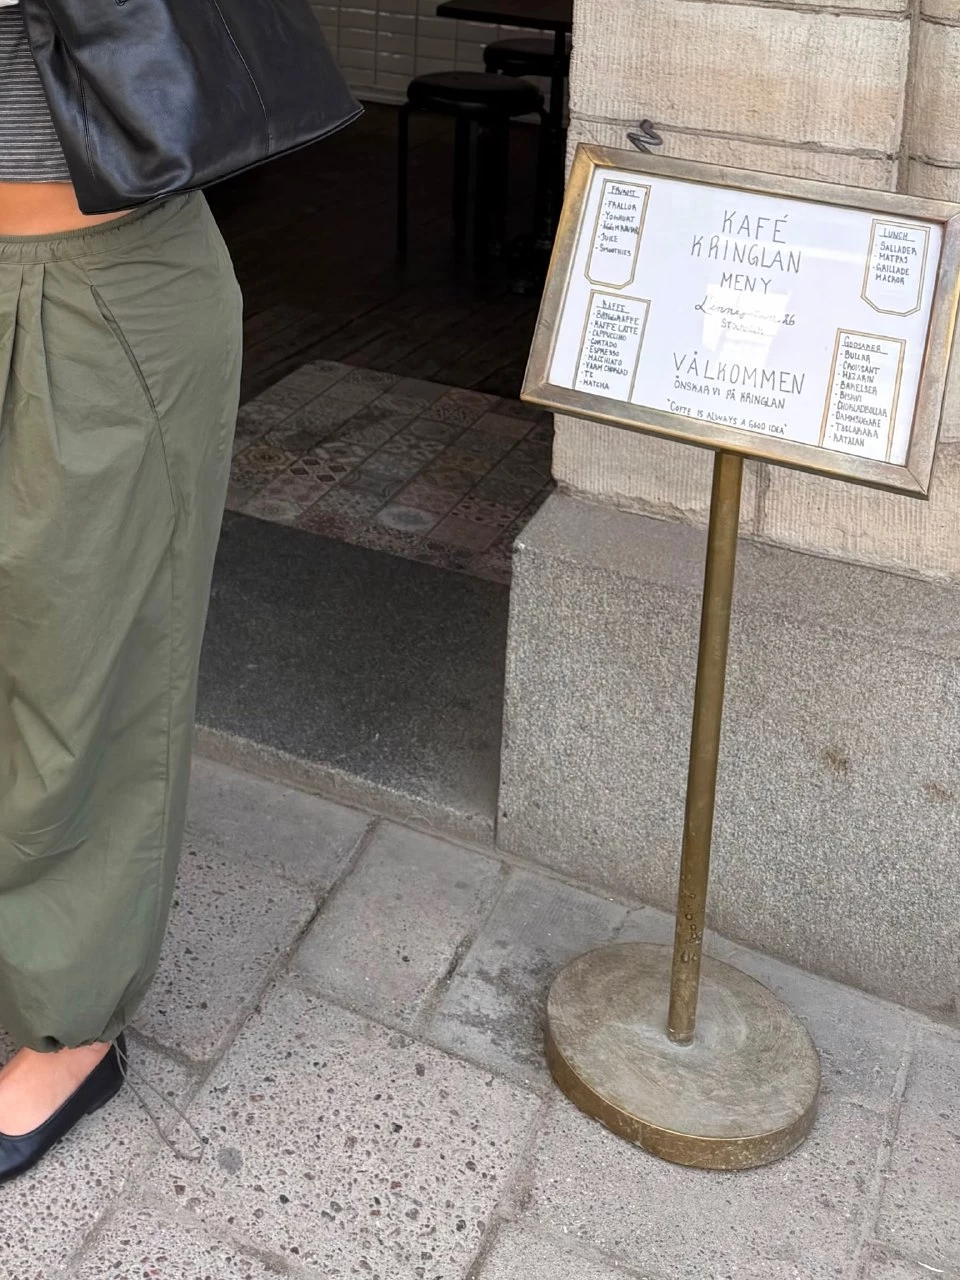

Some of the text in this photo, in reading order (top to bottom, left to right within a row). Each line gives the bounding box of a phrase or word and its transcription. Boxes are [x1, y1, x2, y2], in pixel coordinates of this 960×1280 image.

[721, 209, 789, 244] KAFÉ
[883, 228, 909, 240] LUNCH
[691, 234, 802, 274] KRINGLAN
[880, 241, 917, 256] SALLADER
[720, 272, 772, 295] MENY
[844, 350, 871, 364] BULLAR
[740, 391, 786, 410] KRINGLAN
